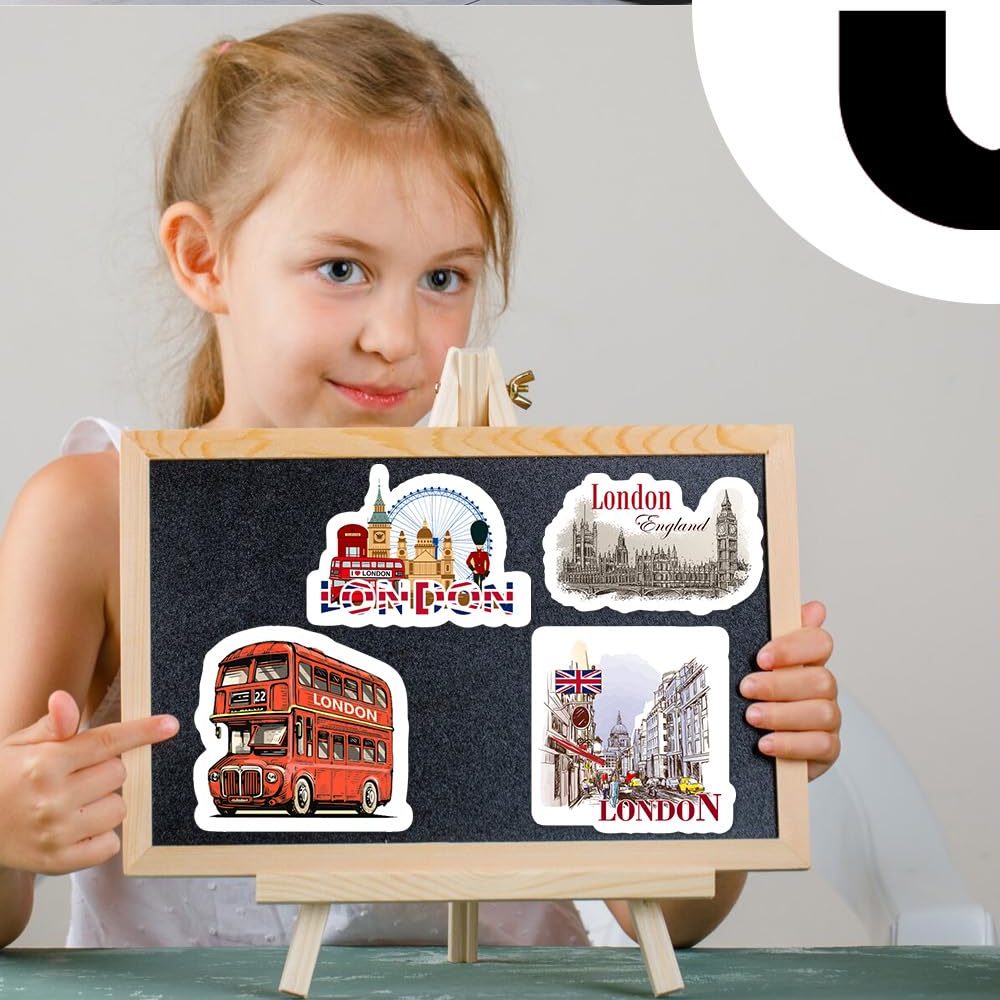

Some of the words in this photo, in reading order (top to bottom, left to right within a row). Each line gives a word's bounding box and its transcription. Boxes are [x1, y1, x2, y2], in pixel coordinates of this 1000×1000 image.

[591, 483, 672, 510] London
[635, 514, 711, 540] England
[320, 579, 514, 616] LONDON
[254, 691, 266, 703] 22
[313, 692, 378, 722] LONDON
[598, 793, 722, 822] LONDON
